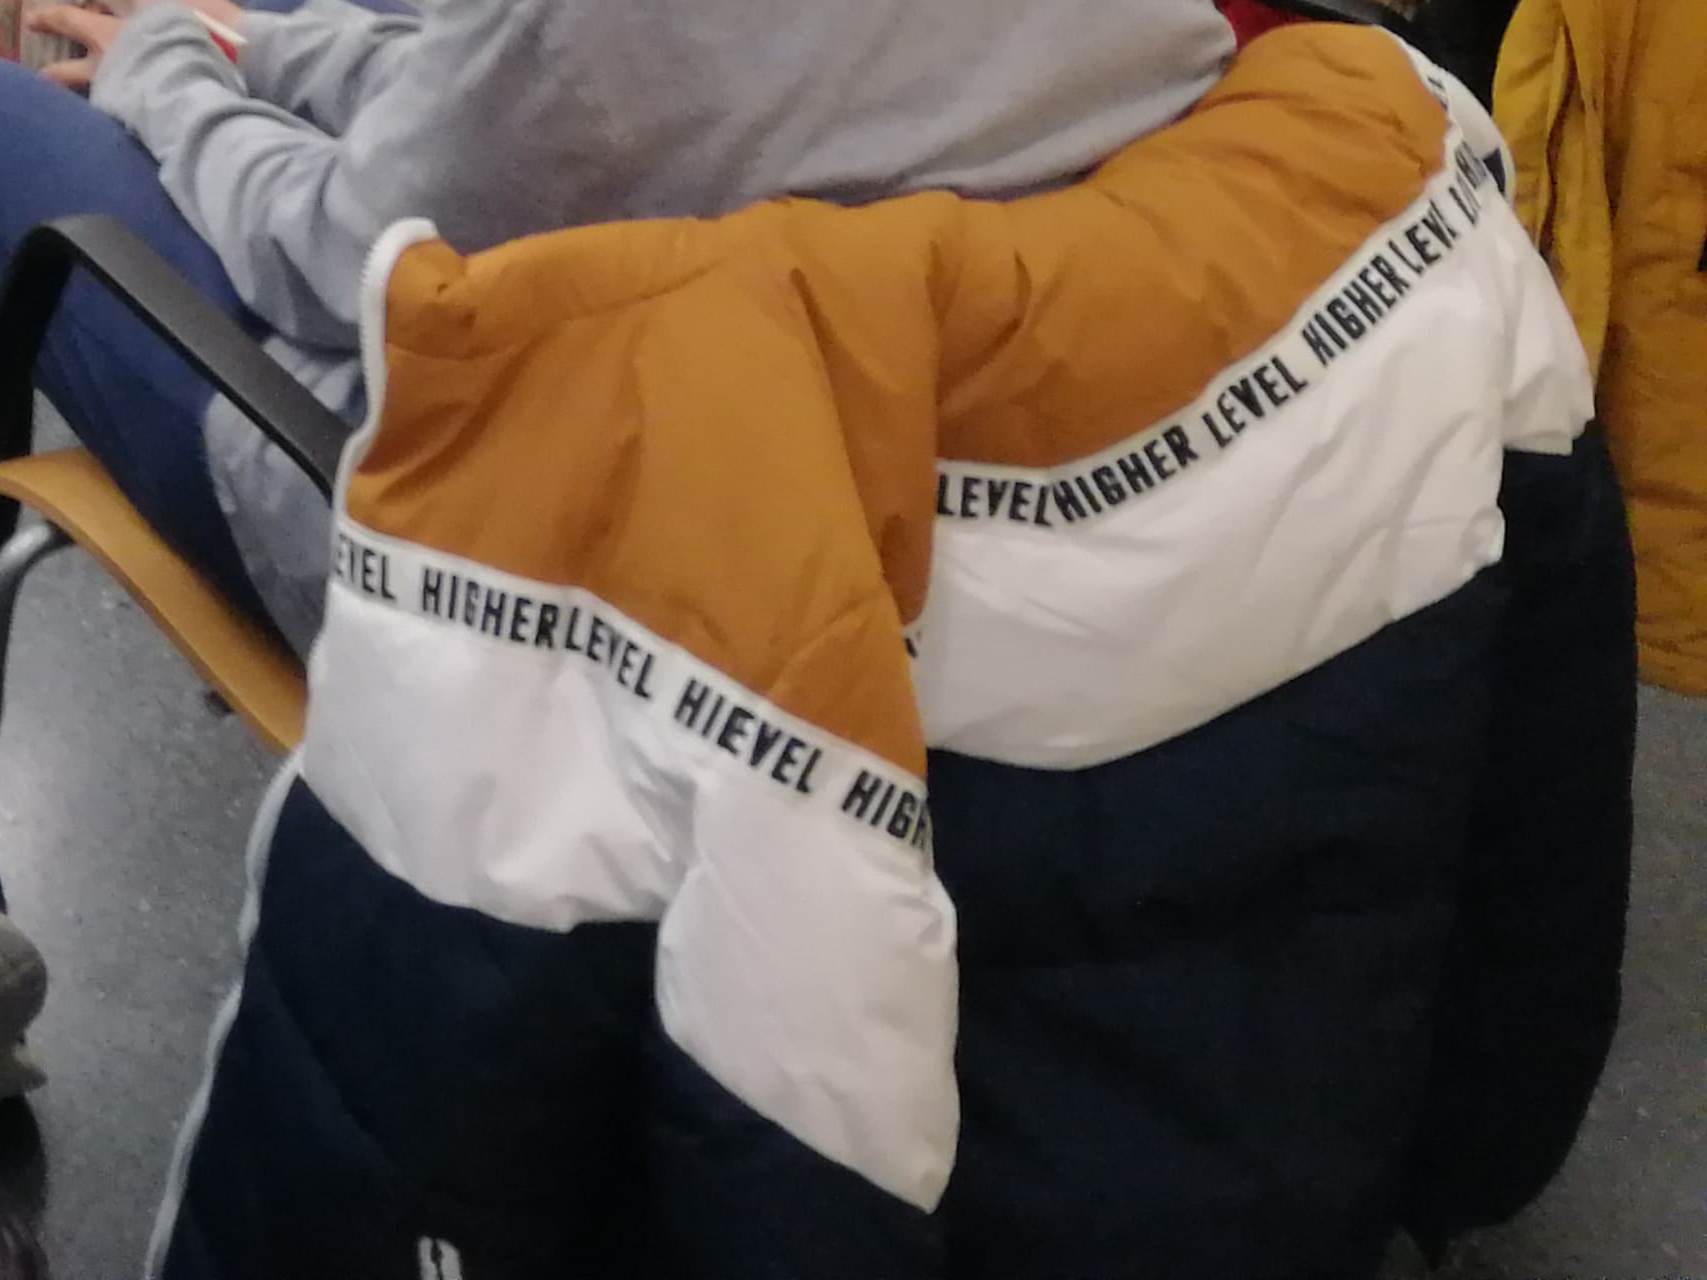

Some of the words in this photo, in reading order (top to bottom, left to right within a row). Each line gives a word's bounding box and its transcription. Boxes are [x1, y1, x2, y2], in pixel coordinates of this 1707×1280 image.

[1300, 251, 1411, 367] HIGHER
[936, 472, 1053, 528] LEVEL
[1052, 423, 1199, 524] HIGHER
[1203, 354, 1309, 449] LEVEL
[421, 566, 560, 651] HIGHER
[564, 605, 657, 700] LEVEL
